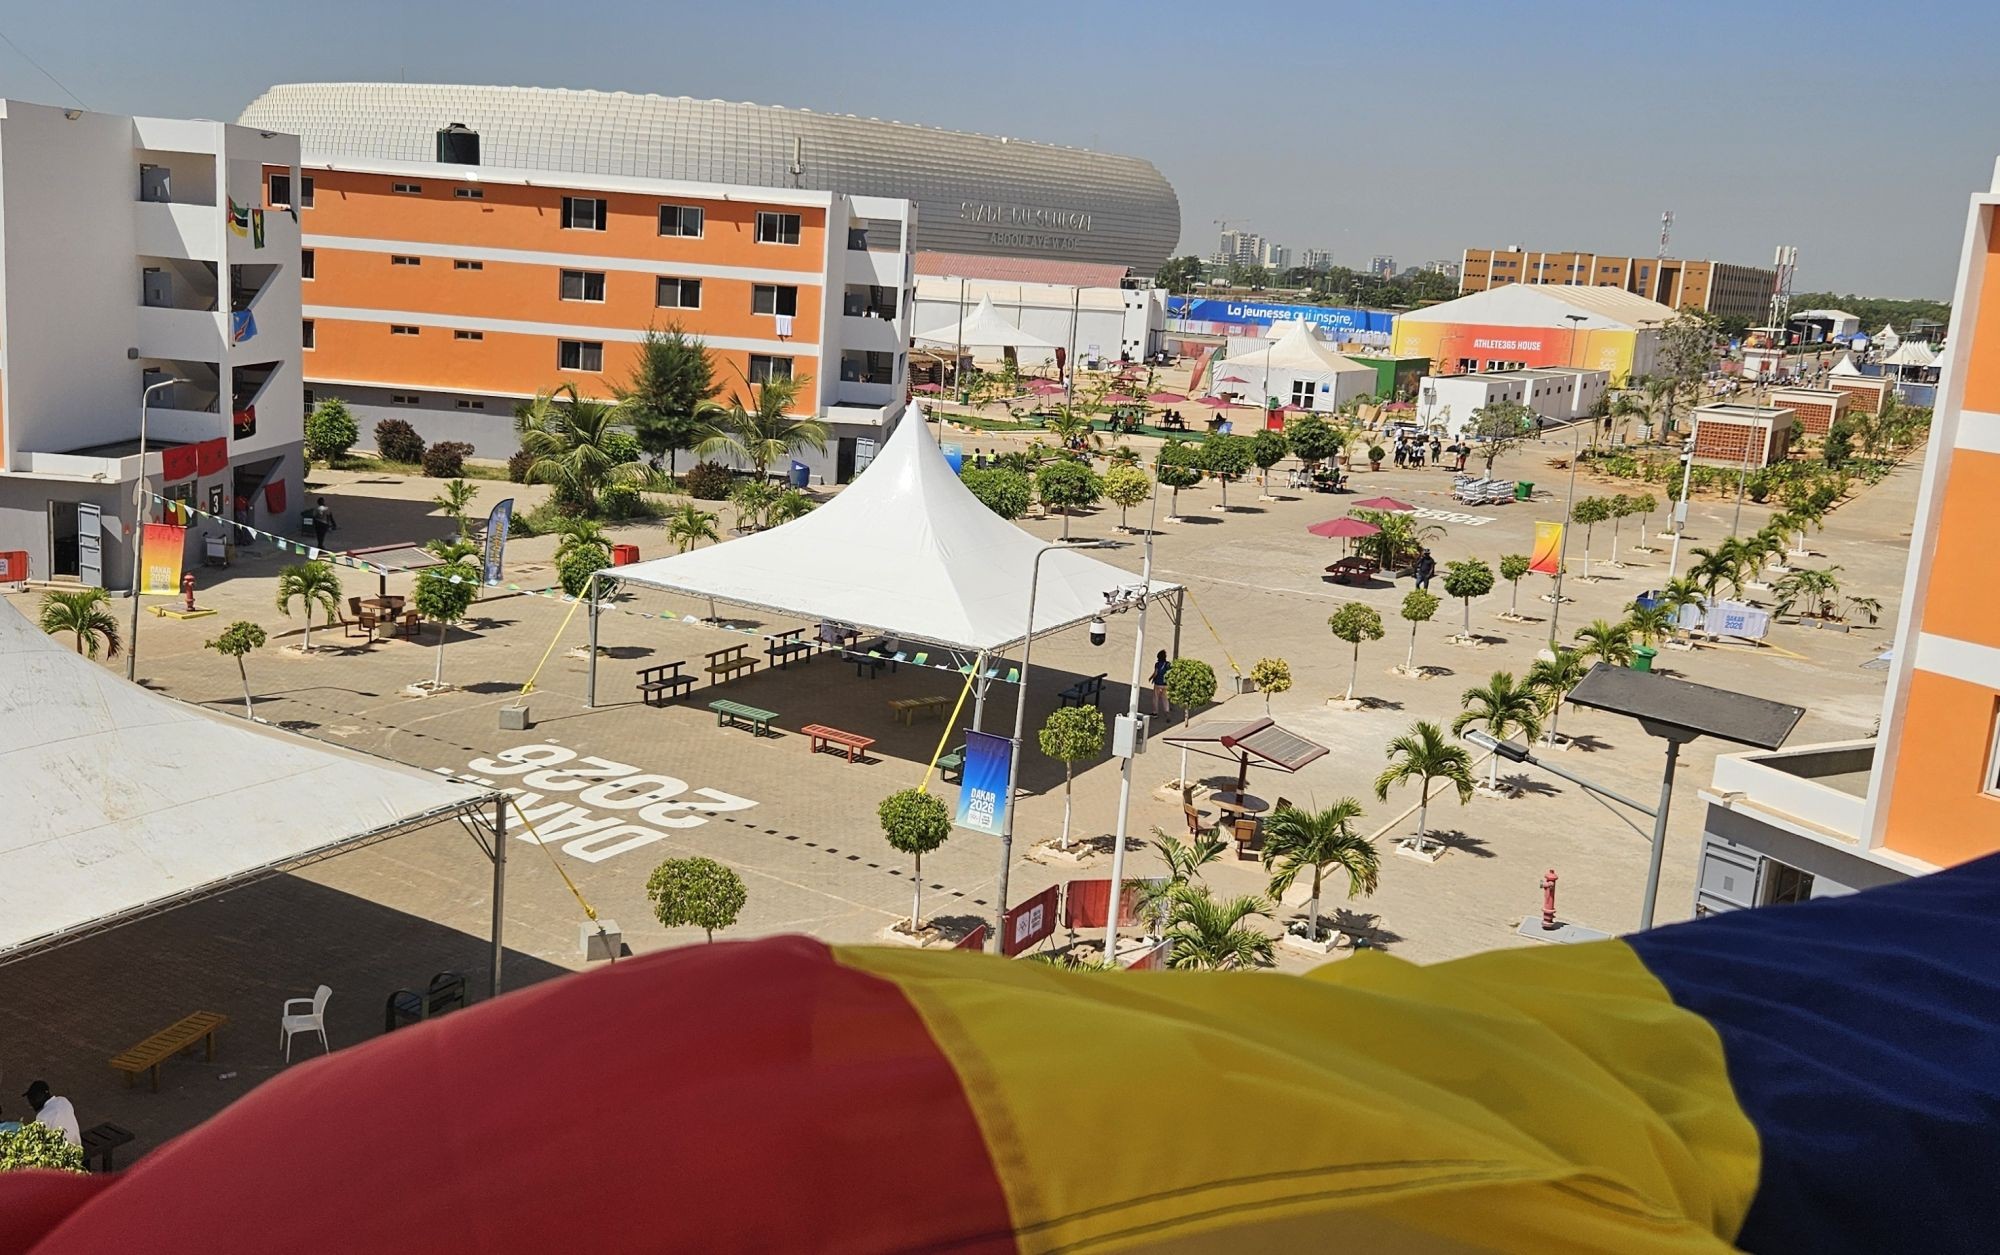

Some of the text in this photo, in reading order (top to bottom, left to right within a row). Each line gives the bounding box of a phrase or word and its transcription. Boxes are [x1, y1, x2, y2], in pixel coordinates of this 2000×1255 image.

[990, 231, 1080, 250] ABDOULAYE WADE
[1227, 304, 1242, 316] La
[1242, 304, 1292, 319] jeunesse
[1313, 311, 1353, 327] inspire,
[1473, 338, 1541, 351] ATHLETE365 HOUSE
[213, 494, 219, 513] 3
[1725, 621, 1744, 630] 2026
[468, 744, 760, 829] 2026
[970, 787, 996, 803] DAKAR
[970, 798, 995, 814] 2026
